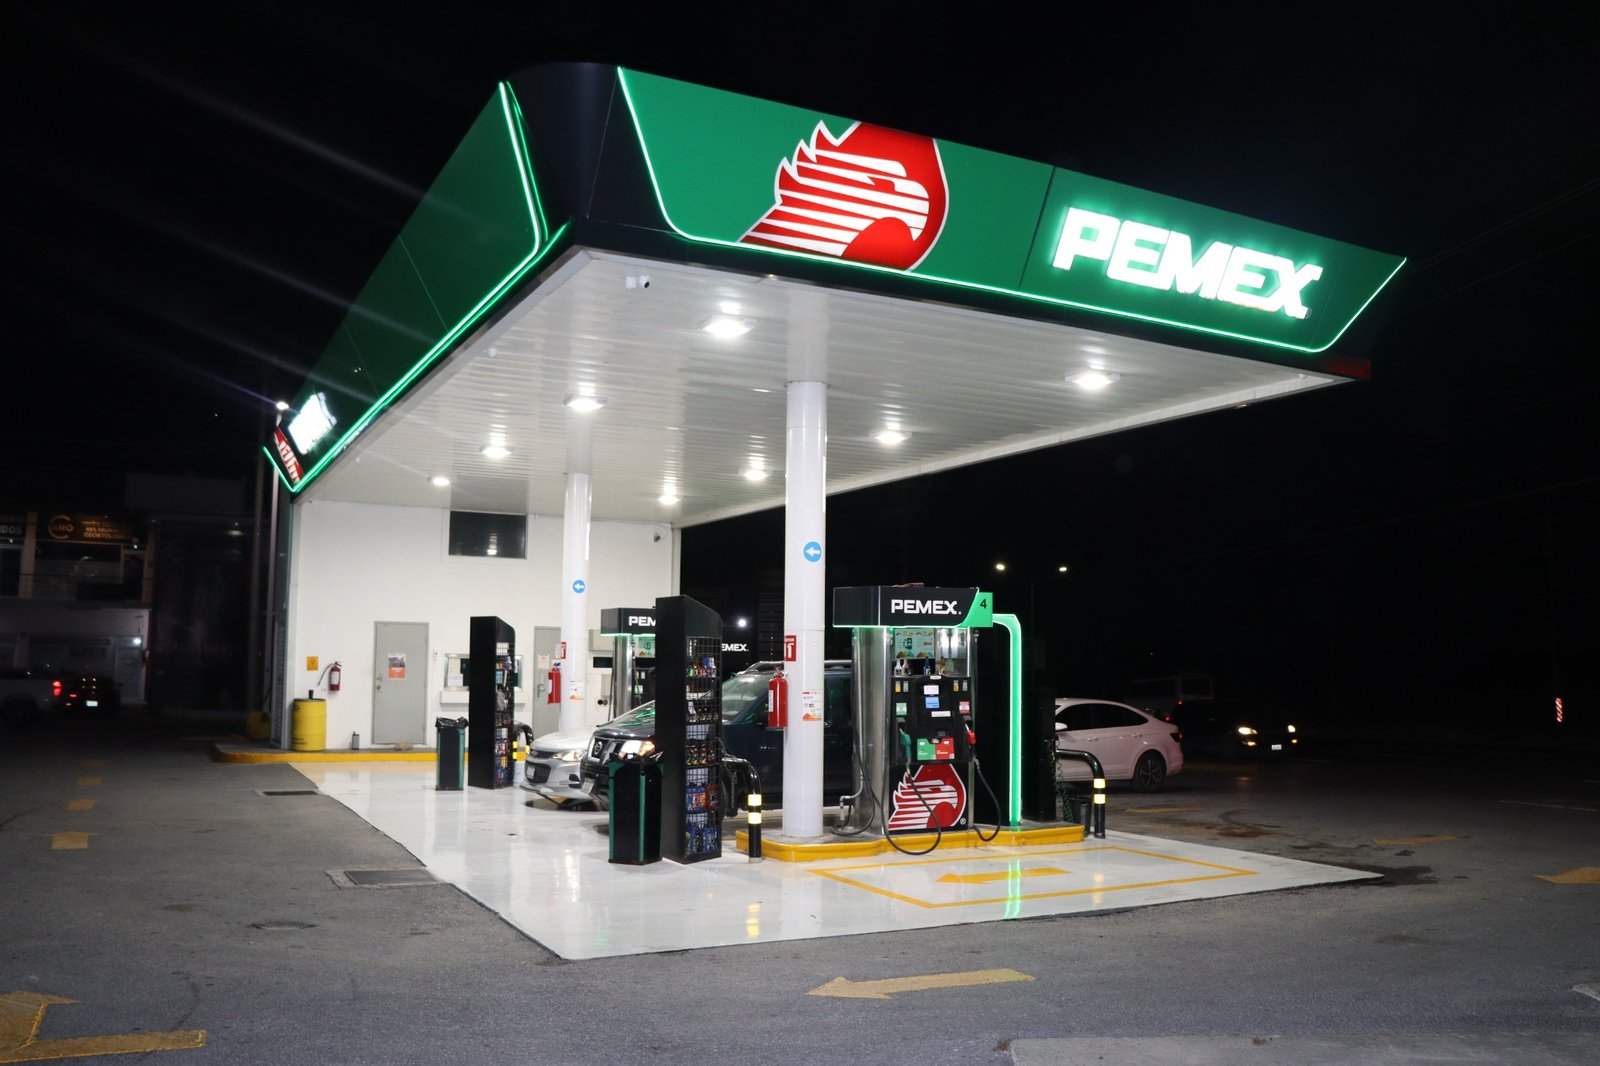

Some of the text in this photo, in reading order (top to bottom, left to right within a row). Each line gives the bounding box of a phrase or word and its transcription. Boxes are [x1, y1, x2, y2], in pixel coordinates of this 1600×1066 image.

[1052, 207, 1323, 319] PEMEX
[891, 599, 957, 615] PEMEX
[979, 598, 987, 609] 4
[628, 616, 657, 627] PEM
[721, 643, 748, 652] EMEX
